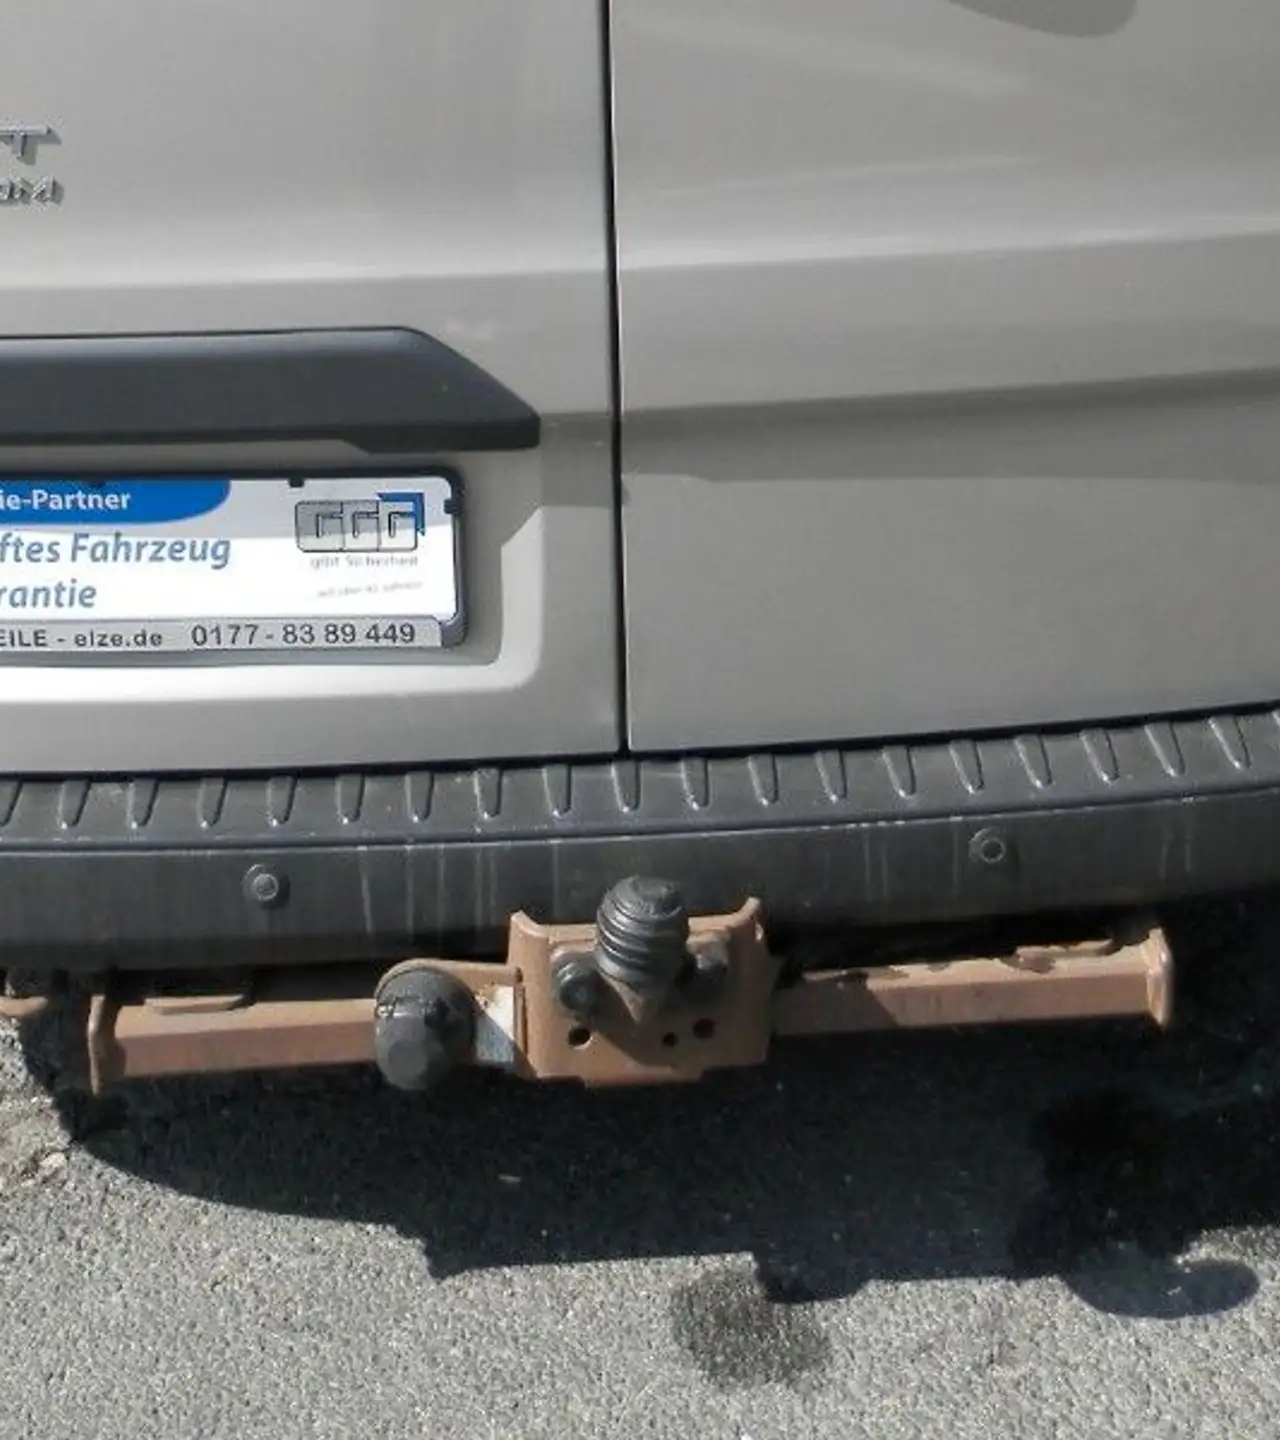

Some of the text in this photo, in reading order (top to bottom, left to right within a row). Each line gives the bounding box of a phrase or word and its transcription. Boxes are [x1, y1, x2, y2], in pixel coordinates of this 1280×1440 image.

[70, 530, 232, 570] Fahrzeug
[73, 628, 164, 648] elze.de
[190, 625, 258, 646] 0177
[282, 624, 315, 645] 83
[324, 624, 357, 644] 89
[365, 623, 416, 644] 449
